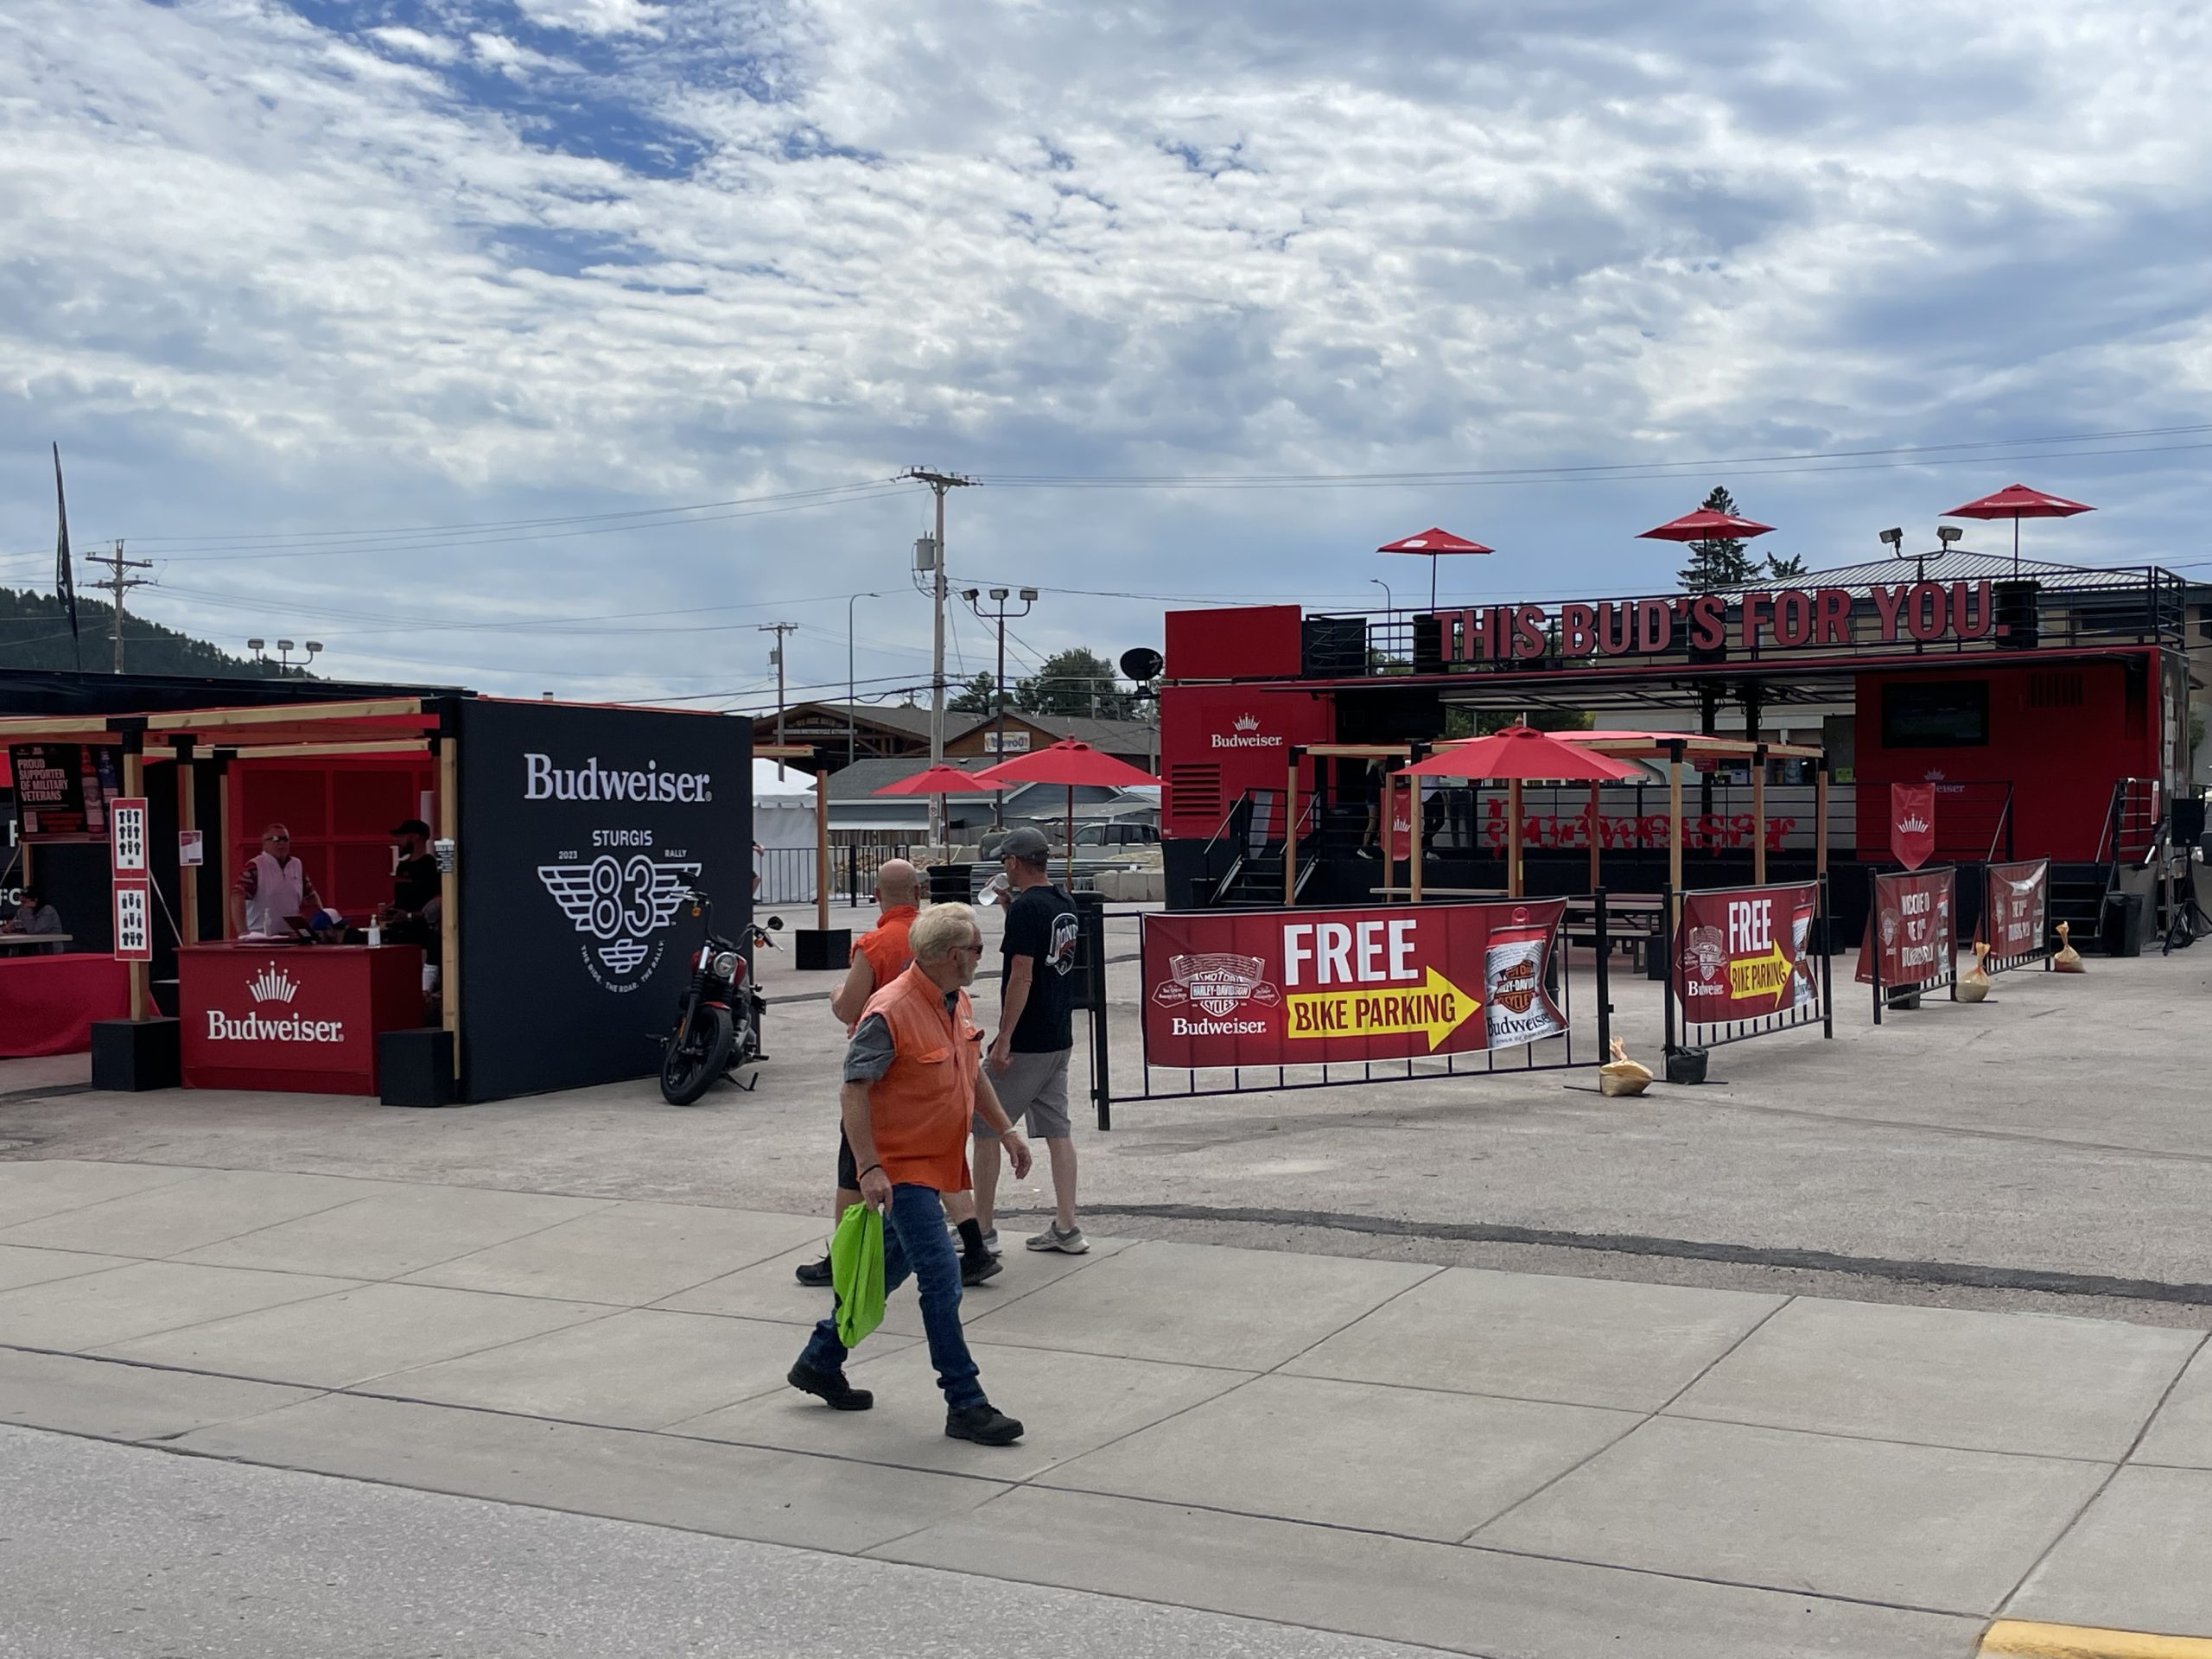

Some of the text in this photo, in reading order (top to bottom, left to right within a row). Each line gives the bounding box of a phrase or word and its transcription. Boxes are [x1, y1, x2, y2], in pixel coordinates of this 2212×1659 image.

[1433, 605, 1547, 662] THIS
[1742, 589, 1852, 648] FOR
[1870, 580, 2011, 641] YOU.
[1211, 733, 1283, 748] Budweiser
[17, 759, 45, 769] PROUD
[19, 768, 65, 780] SUPPORTER
[524, 753, 712, 803] Budweiser
[20, 779, 68, 791] OF MILITARY
[21, 790, 61, 802] VETERANS
[592, 830, 653, 847] STURGIS
[558, 849, 687, 860] 2023 RALLY
[589, 855, 657, 939] 83
[1728, 899, 1772, 954] FREE
[1283, 919, 1419, 986] FREE
[1204, 999, 1235, 1014] CYCLES
[1294, 993, 1456, 1031] BIKE PARKING
[207, 1010, 344, 1042] Budweiser
[1172, 1018, 1267, 1035] Budweiser
